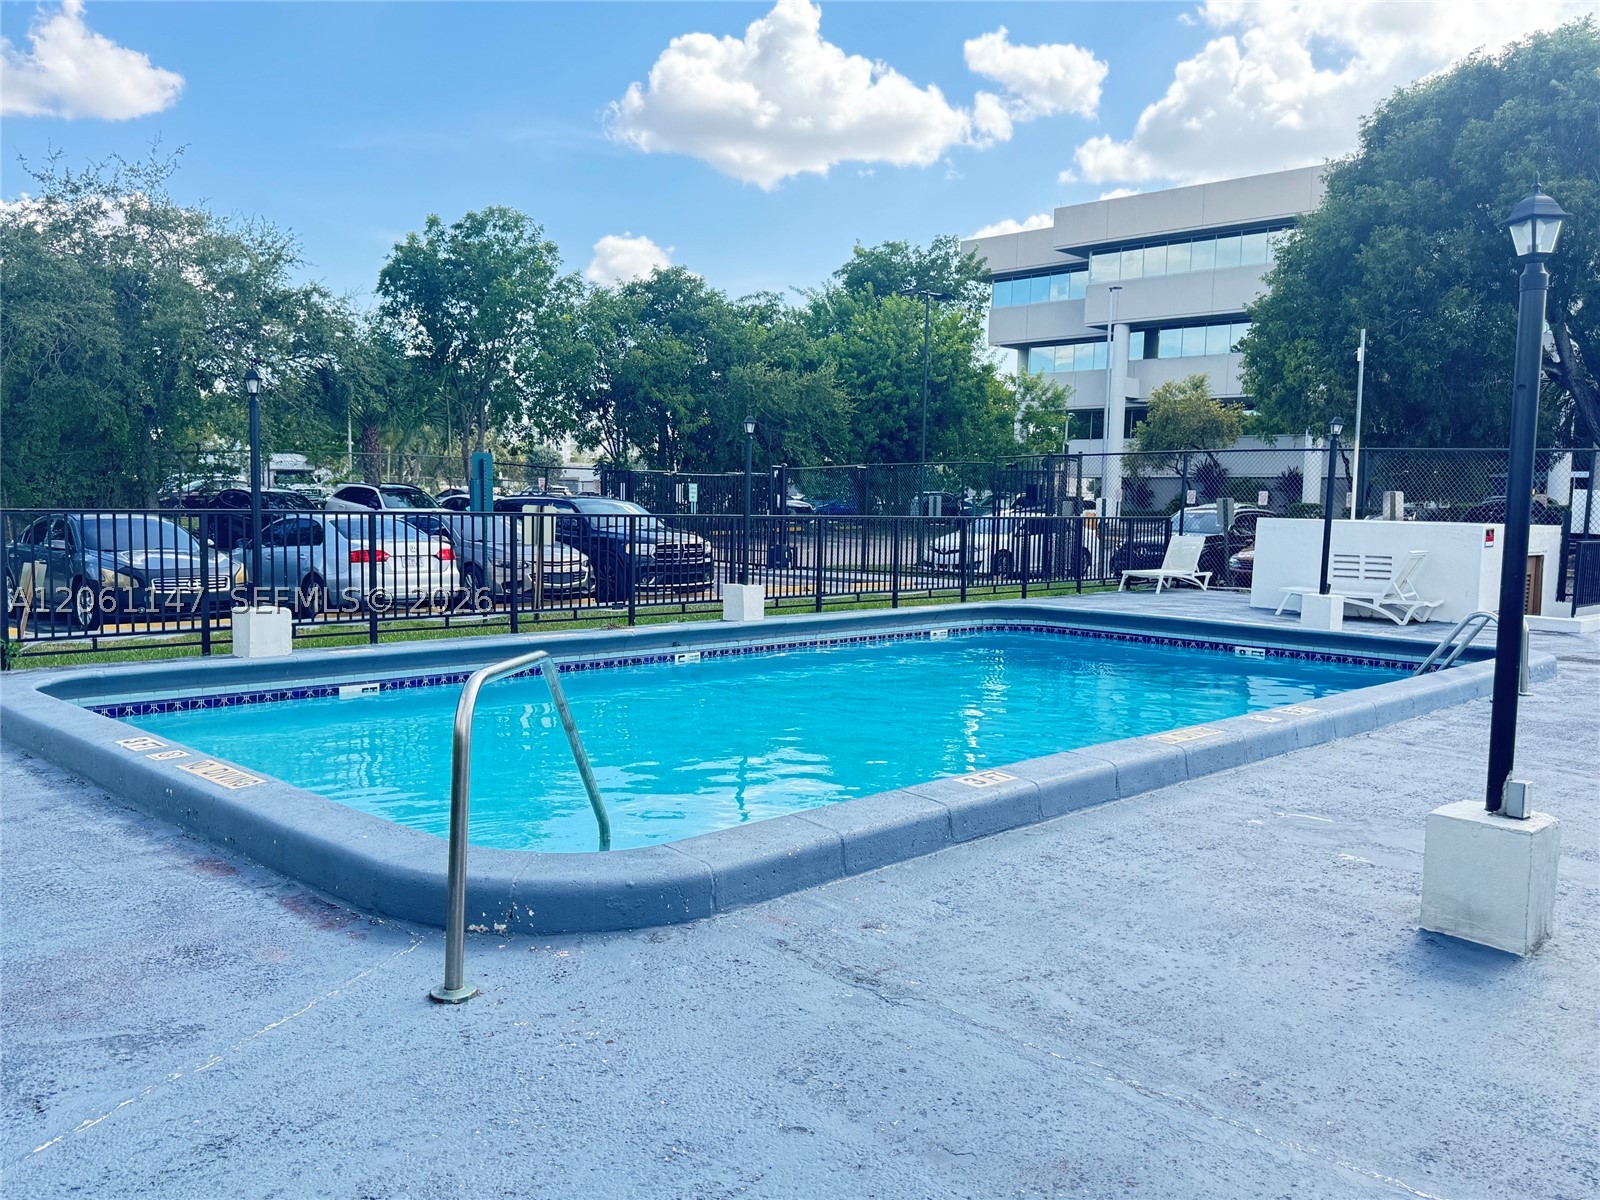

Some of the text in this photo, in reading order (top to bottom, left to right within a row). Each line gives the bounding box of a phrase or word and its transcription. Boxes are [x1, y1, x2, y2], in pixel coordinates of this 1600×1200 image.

[200, 768, 260, 787] DIVING
[962, 771, 1012, 785] 3 FT
